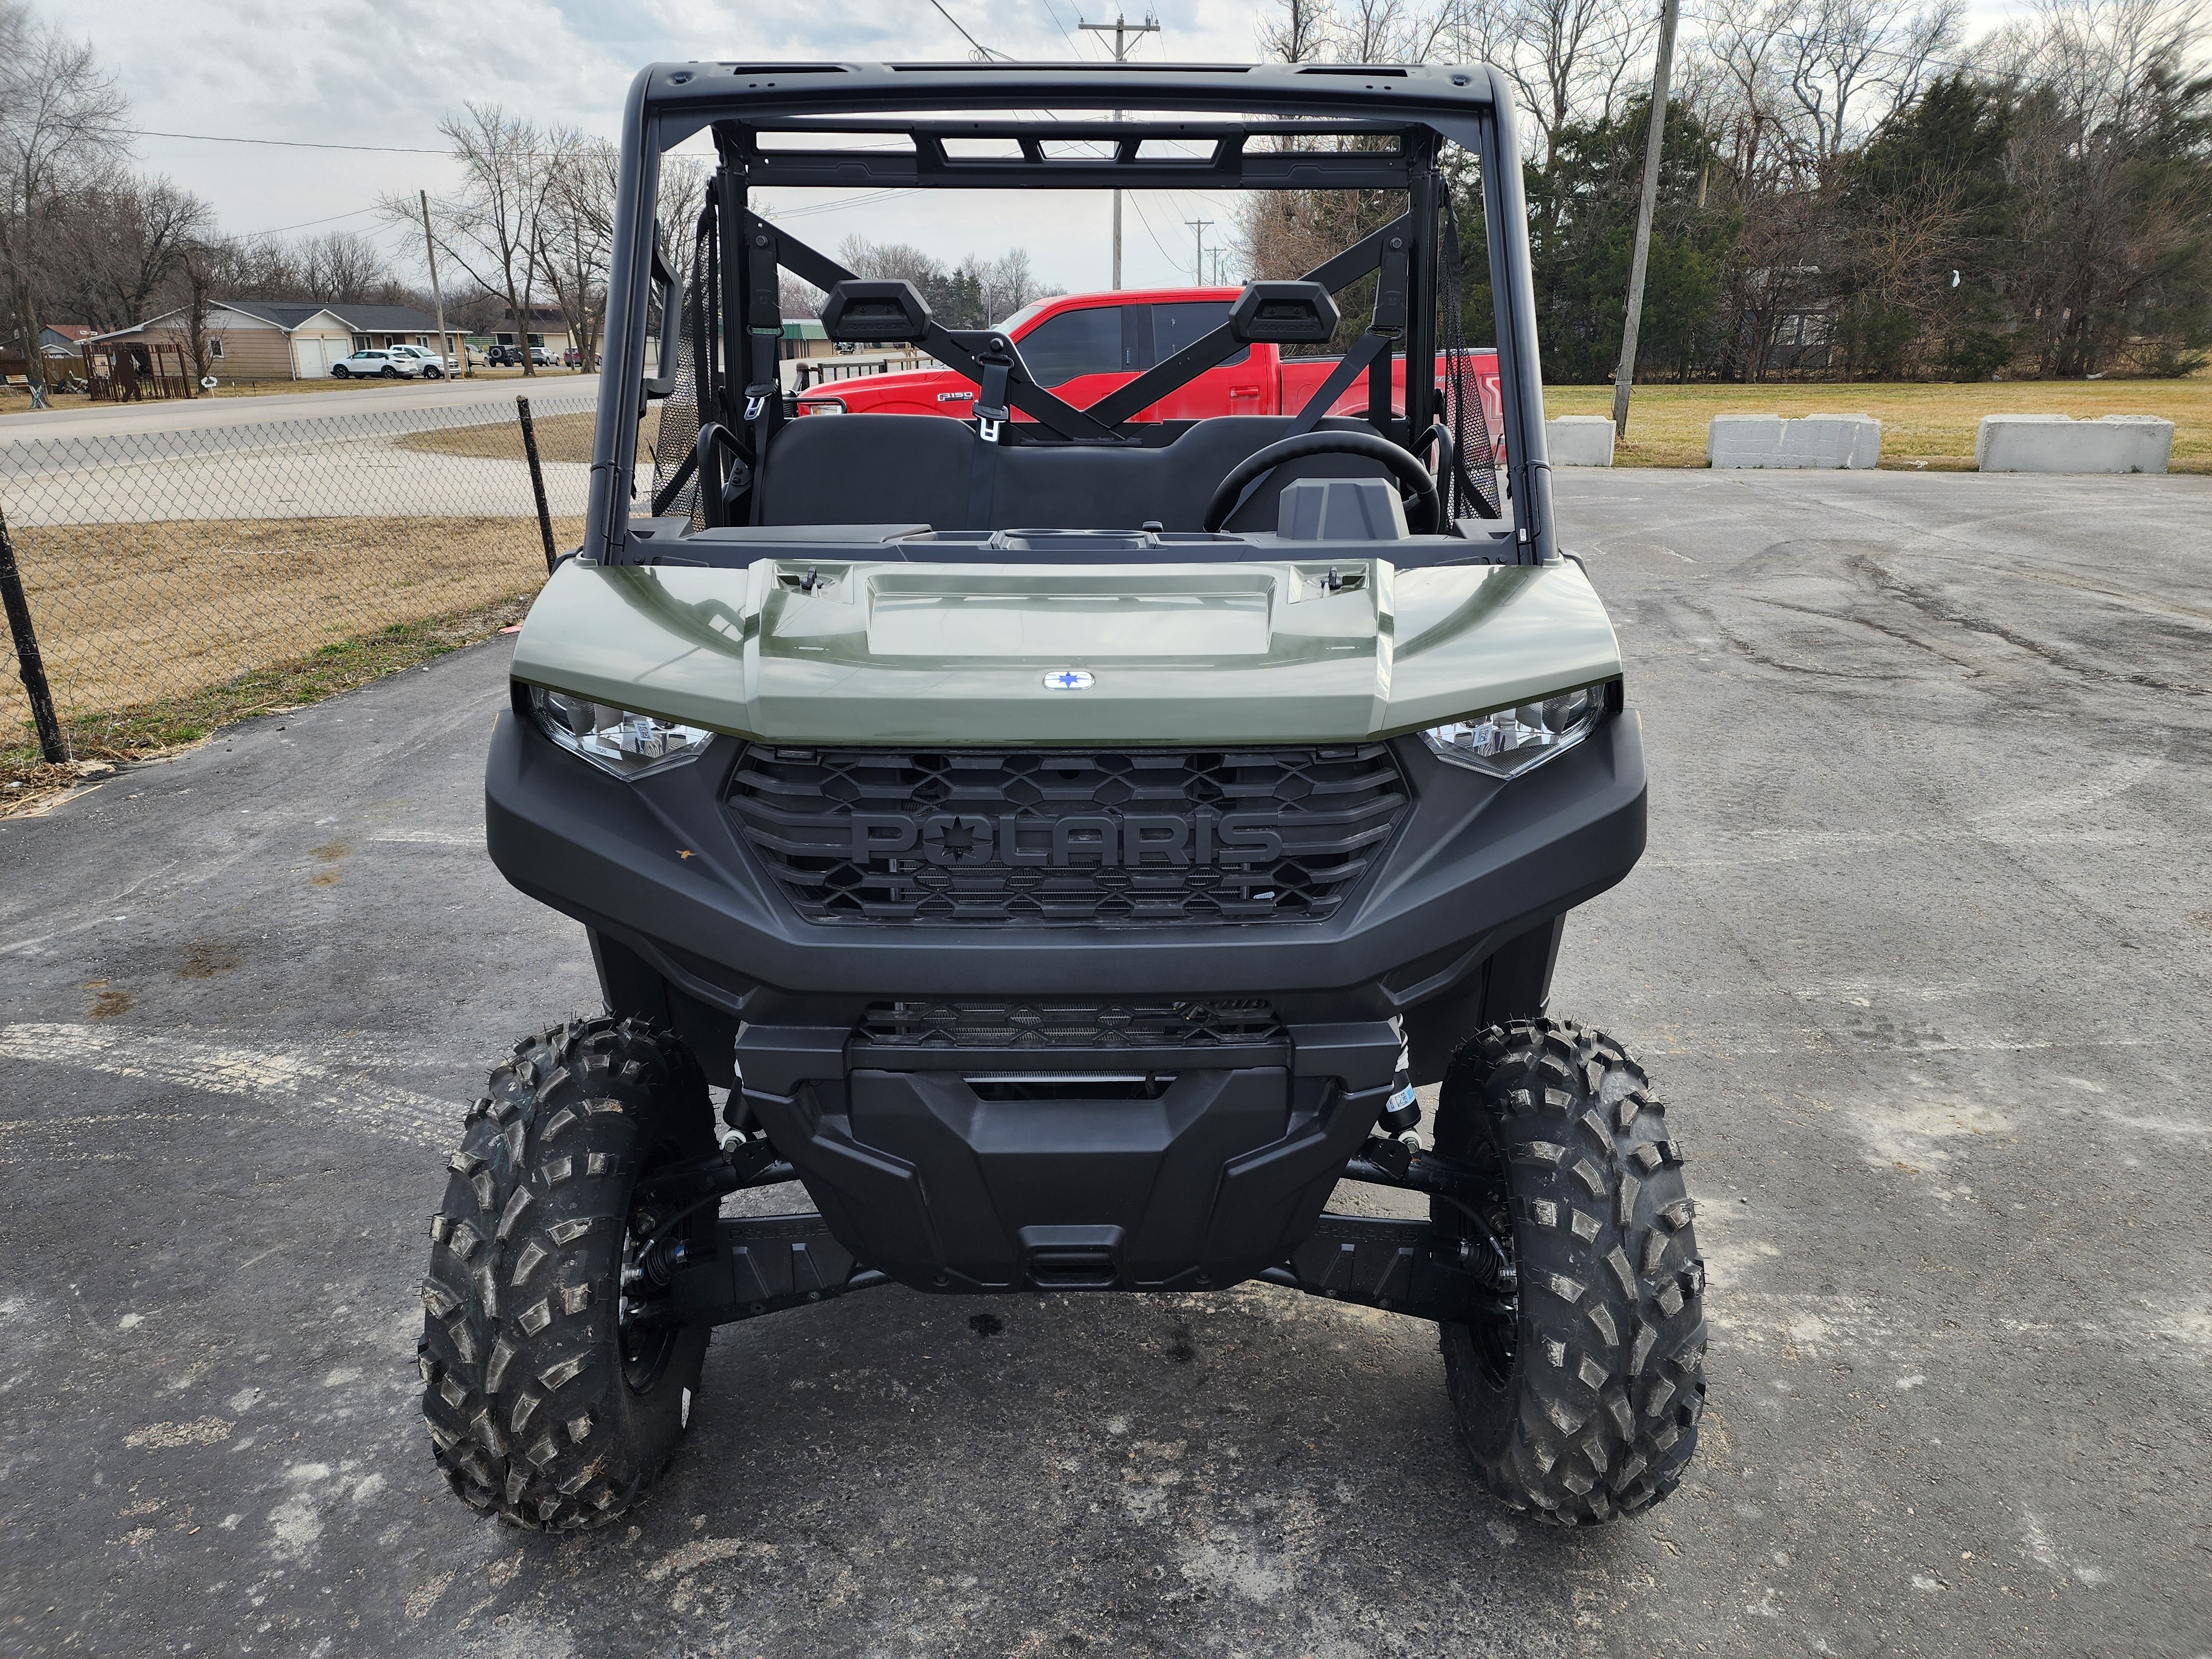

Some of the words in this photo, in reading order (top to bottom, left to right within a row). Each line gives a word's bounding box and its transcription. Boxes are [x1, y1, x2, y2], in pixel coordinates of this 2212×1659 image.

[844, 323, 906, 331] RANGER
[851, 811, 1283, 867] POLARIS
[728, 1221, 832, 1241] POLARIS
[1314, 1224, 1419, 1243] POLARIS
